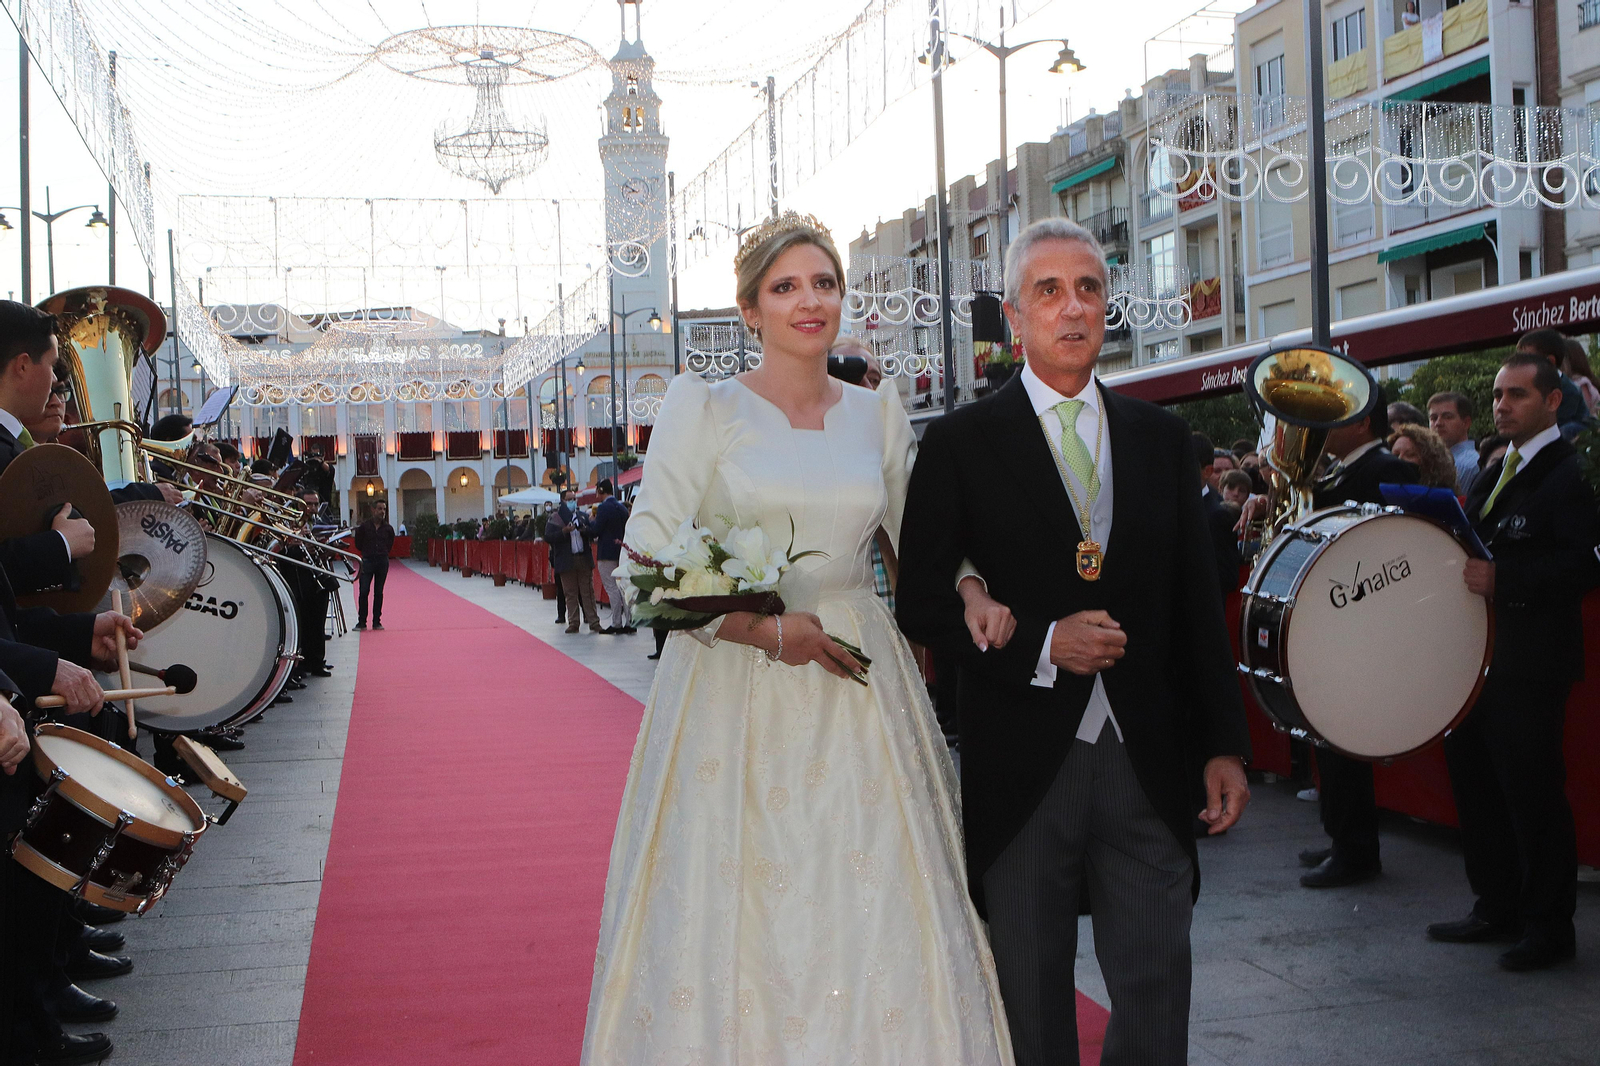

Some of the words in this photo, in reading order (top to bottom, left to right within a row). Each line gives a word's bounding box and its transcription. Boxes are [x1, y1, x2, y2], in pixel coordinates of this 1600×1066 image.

[1512, 301, 1565, 333] Sánchez
[438, 343, 484, 360] 2022
[1201, 369, 1230, 390] Sánchez
[182, 592, 239, 620] BAO
